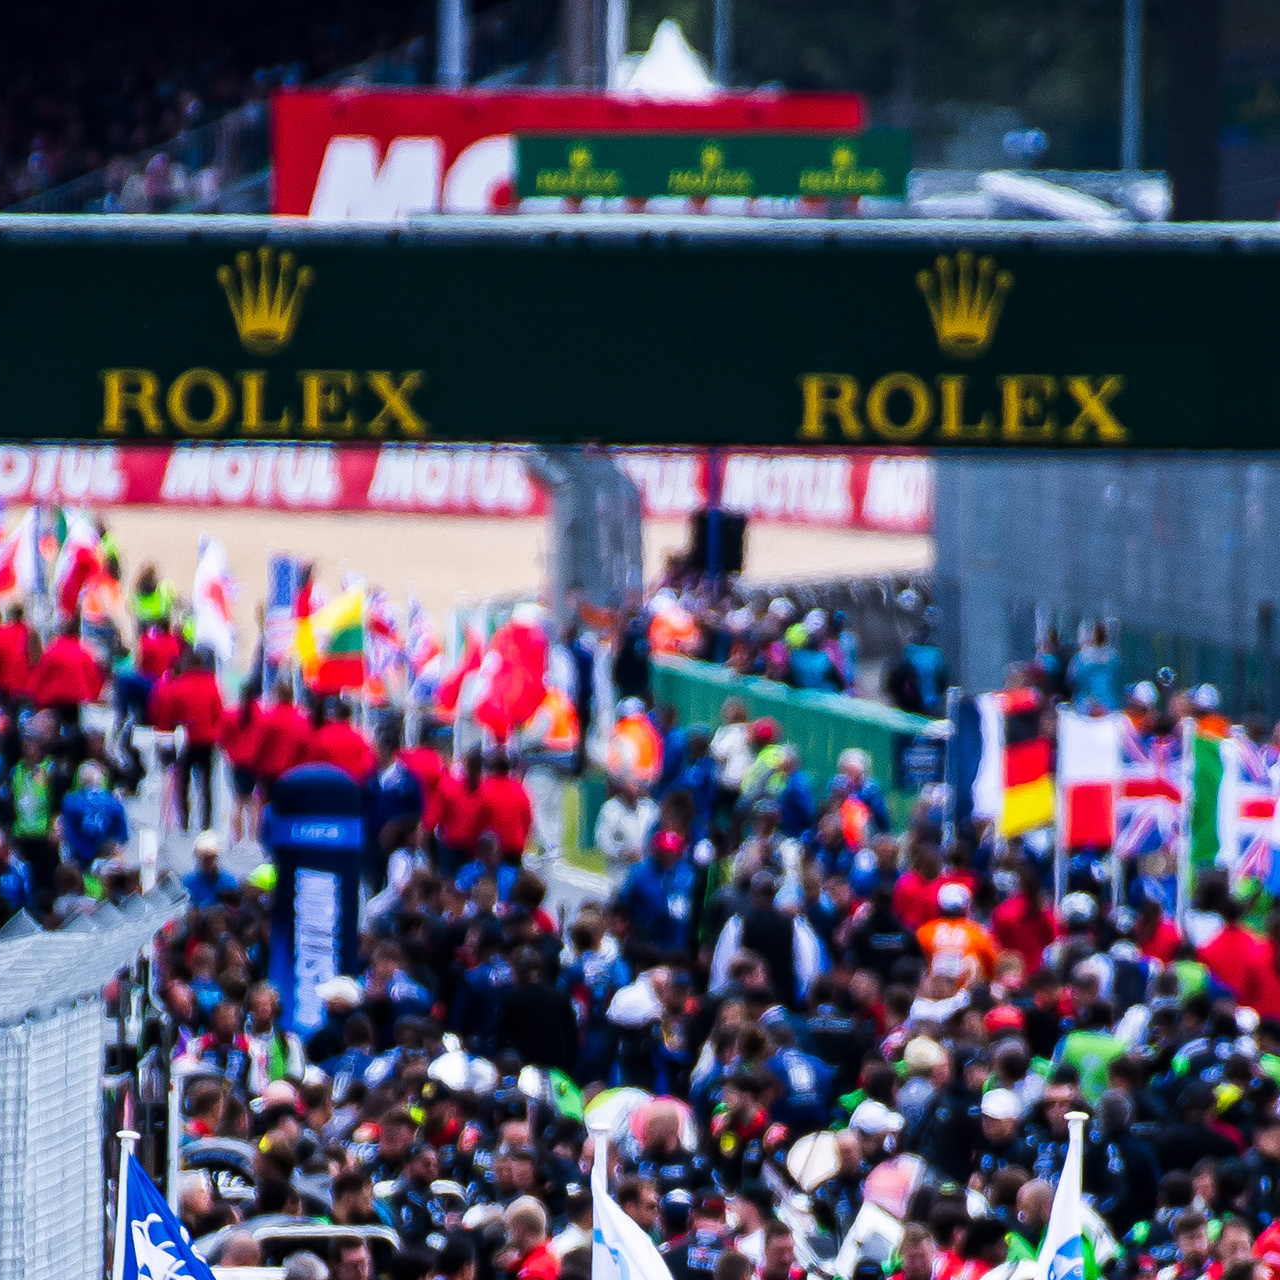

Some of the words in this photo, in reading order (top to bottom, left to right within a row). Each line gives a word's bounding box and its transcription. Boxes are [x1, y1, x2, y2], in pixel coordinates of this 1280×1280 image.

[99, 368, 429, 437] ROLEX
[799, 371, 1129, 443] ROLEX
[160, 446, 340, 506] MOTUL
